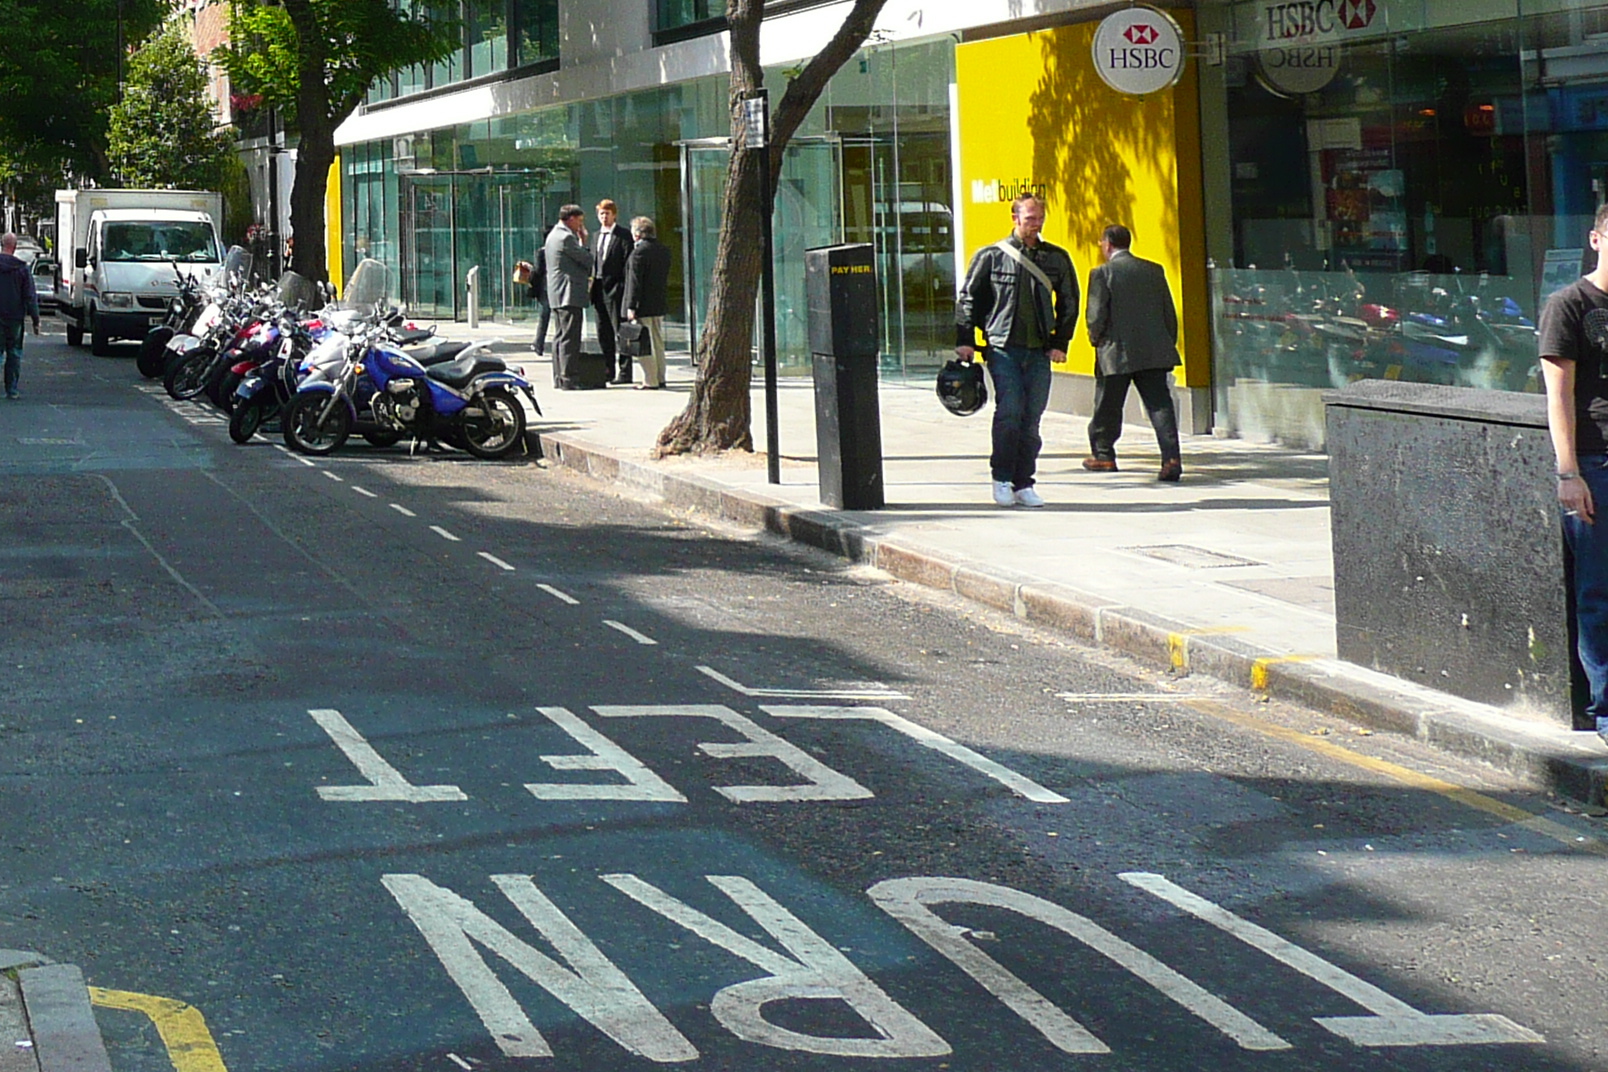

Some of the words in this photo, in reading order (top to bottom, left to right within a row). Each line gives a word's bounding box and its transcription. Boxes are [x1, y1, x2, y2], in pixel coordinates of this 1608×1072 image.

[1110, 47, 1174, 69] HSBC
[832, 266, 849, 274] PAY
[851, 265, 872, 273] HER
[308, 704, 1070, 804] LEFT
[380, 871, 1547, 1062] TURN
